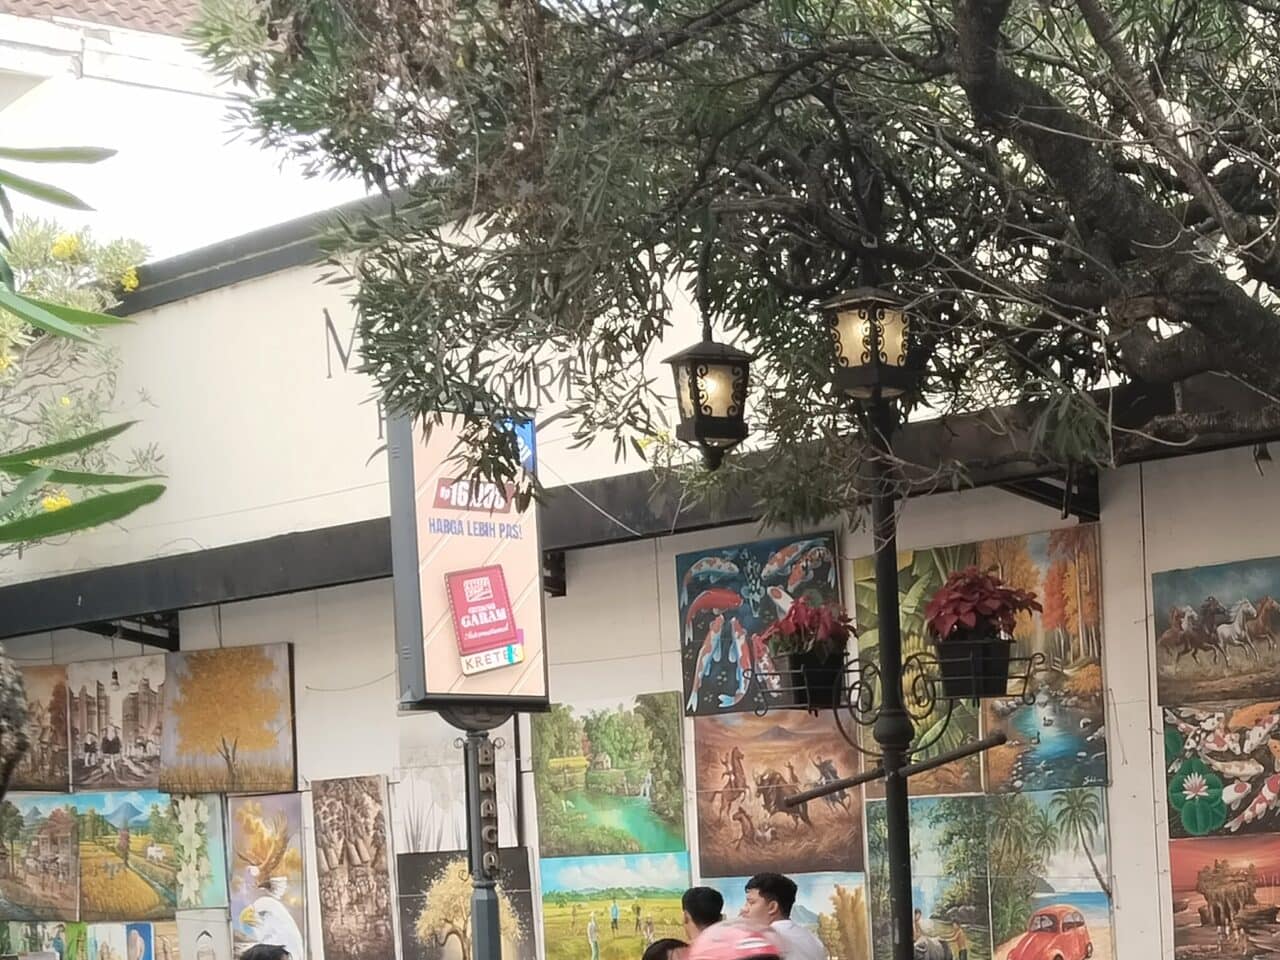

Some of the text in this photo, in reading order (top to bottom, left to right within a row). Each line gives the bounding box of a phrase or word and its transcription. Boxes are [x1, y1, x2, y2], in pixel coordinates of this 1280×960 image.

[428, 518, 523, 540] HARGA LEBIH PAS!
